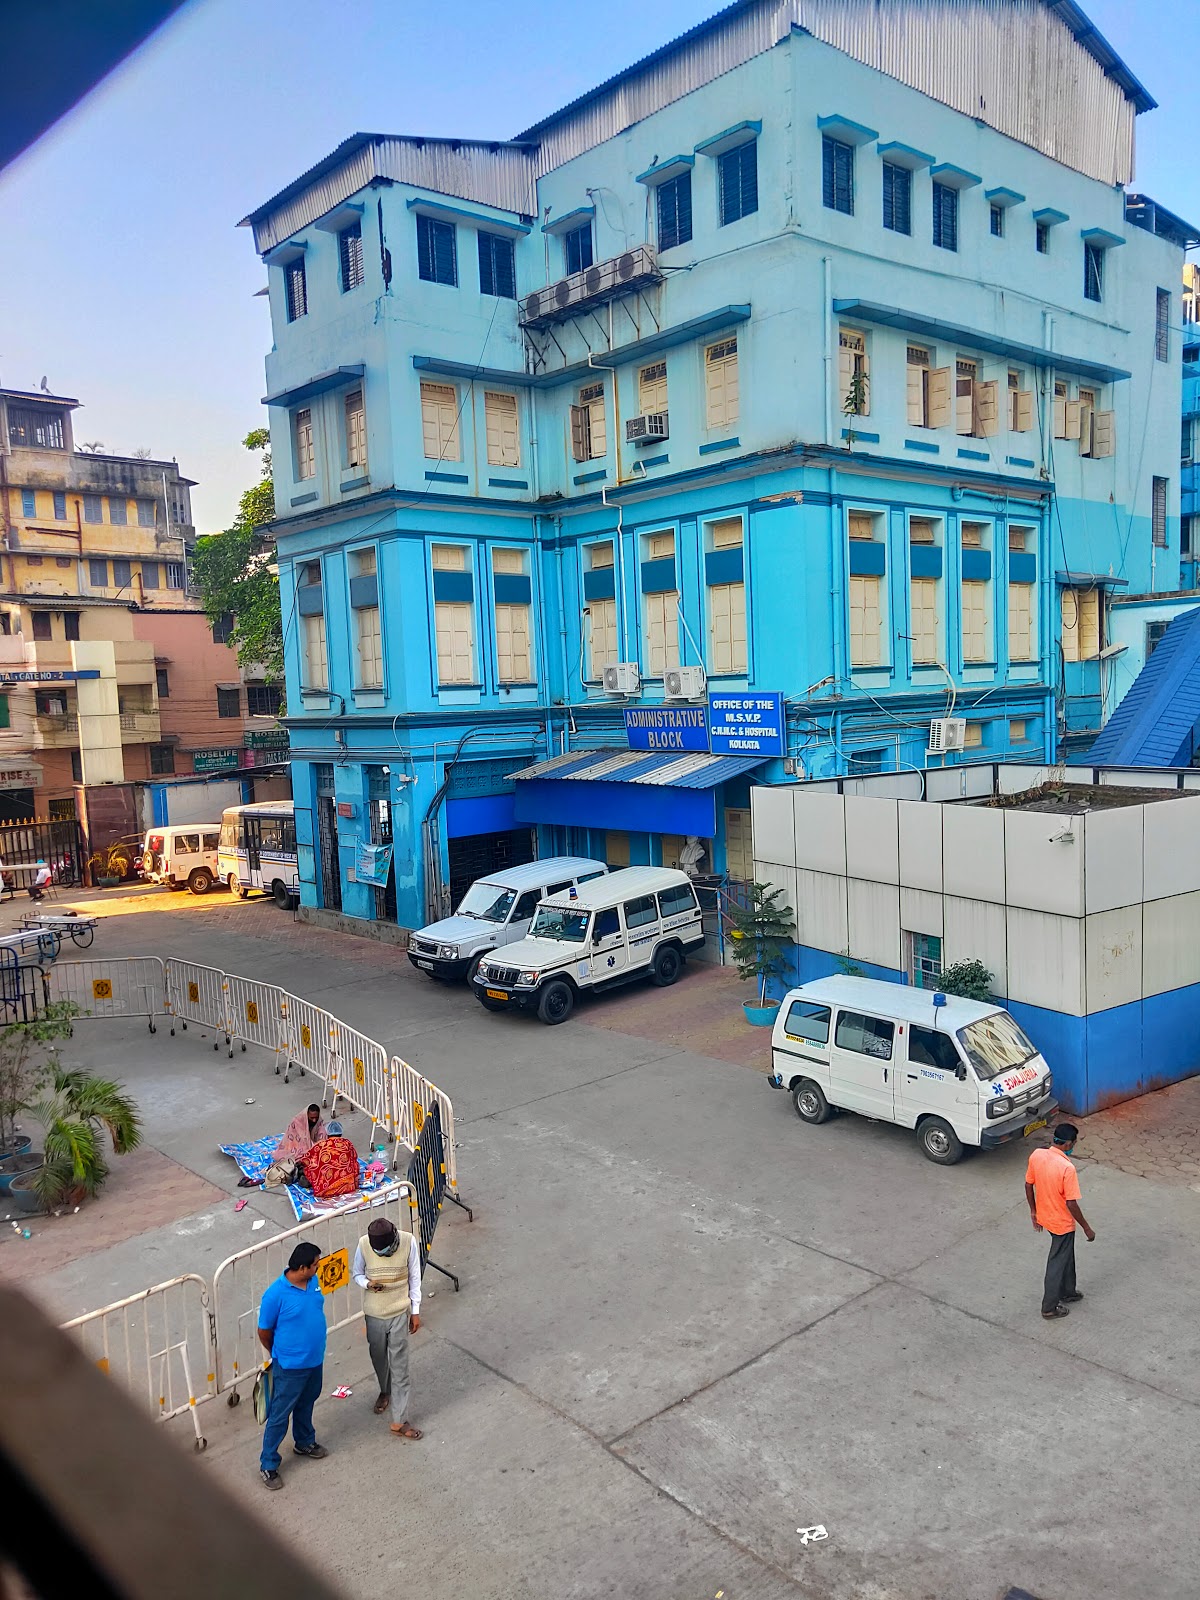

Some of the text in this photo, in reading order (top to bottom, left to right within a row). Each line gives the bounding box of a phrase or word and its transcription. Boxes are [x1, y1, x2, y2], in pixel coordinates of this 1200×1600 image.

[19, 672, 40, 680] GATE
[40, 672, 52, 680] NO
[58, 671, 64, 679] 2
[712, 699, 775, 710] OFFICE OF THE
[626, 710, 705, 728] ADMINISTRATIVE
[725, 713, 762, 723] M.S.V.P.
[738, 727, 745, 736] &
[744, 727, 779, 737] HOSPITAL
[647, 731, 685, 748] BLOCK
[729, 739, 760, 750] KOLKATA
[194, 749, 238, 759] ROSELIFE
[1, 770, 23, 781] RISE
[542, 899, 593, 909] AMBULANCE
